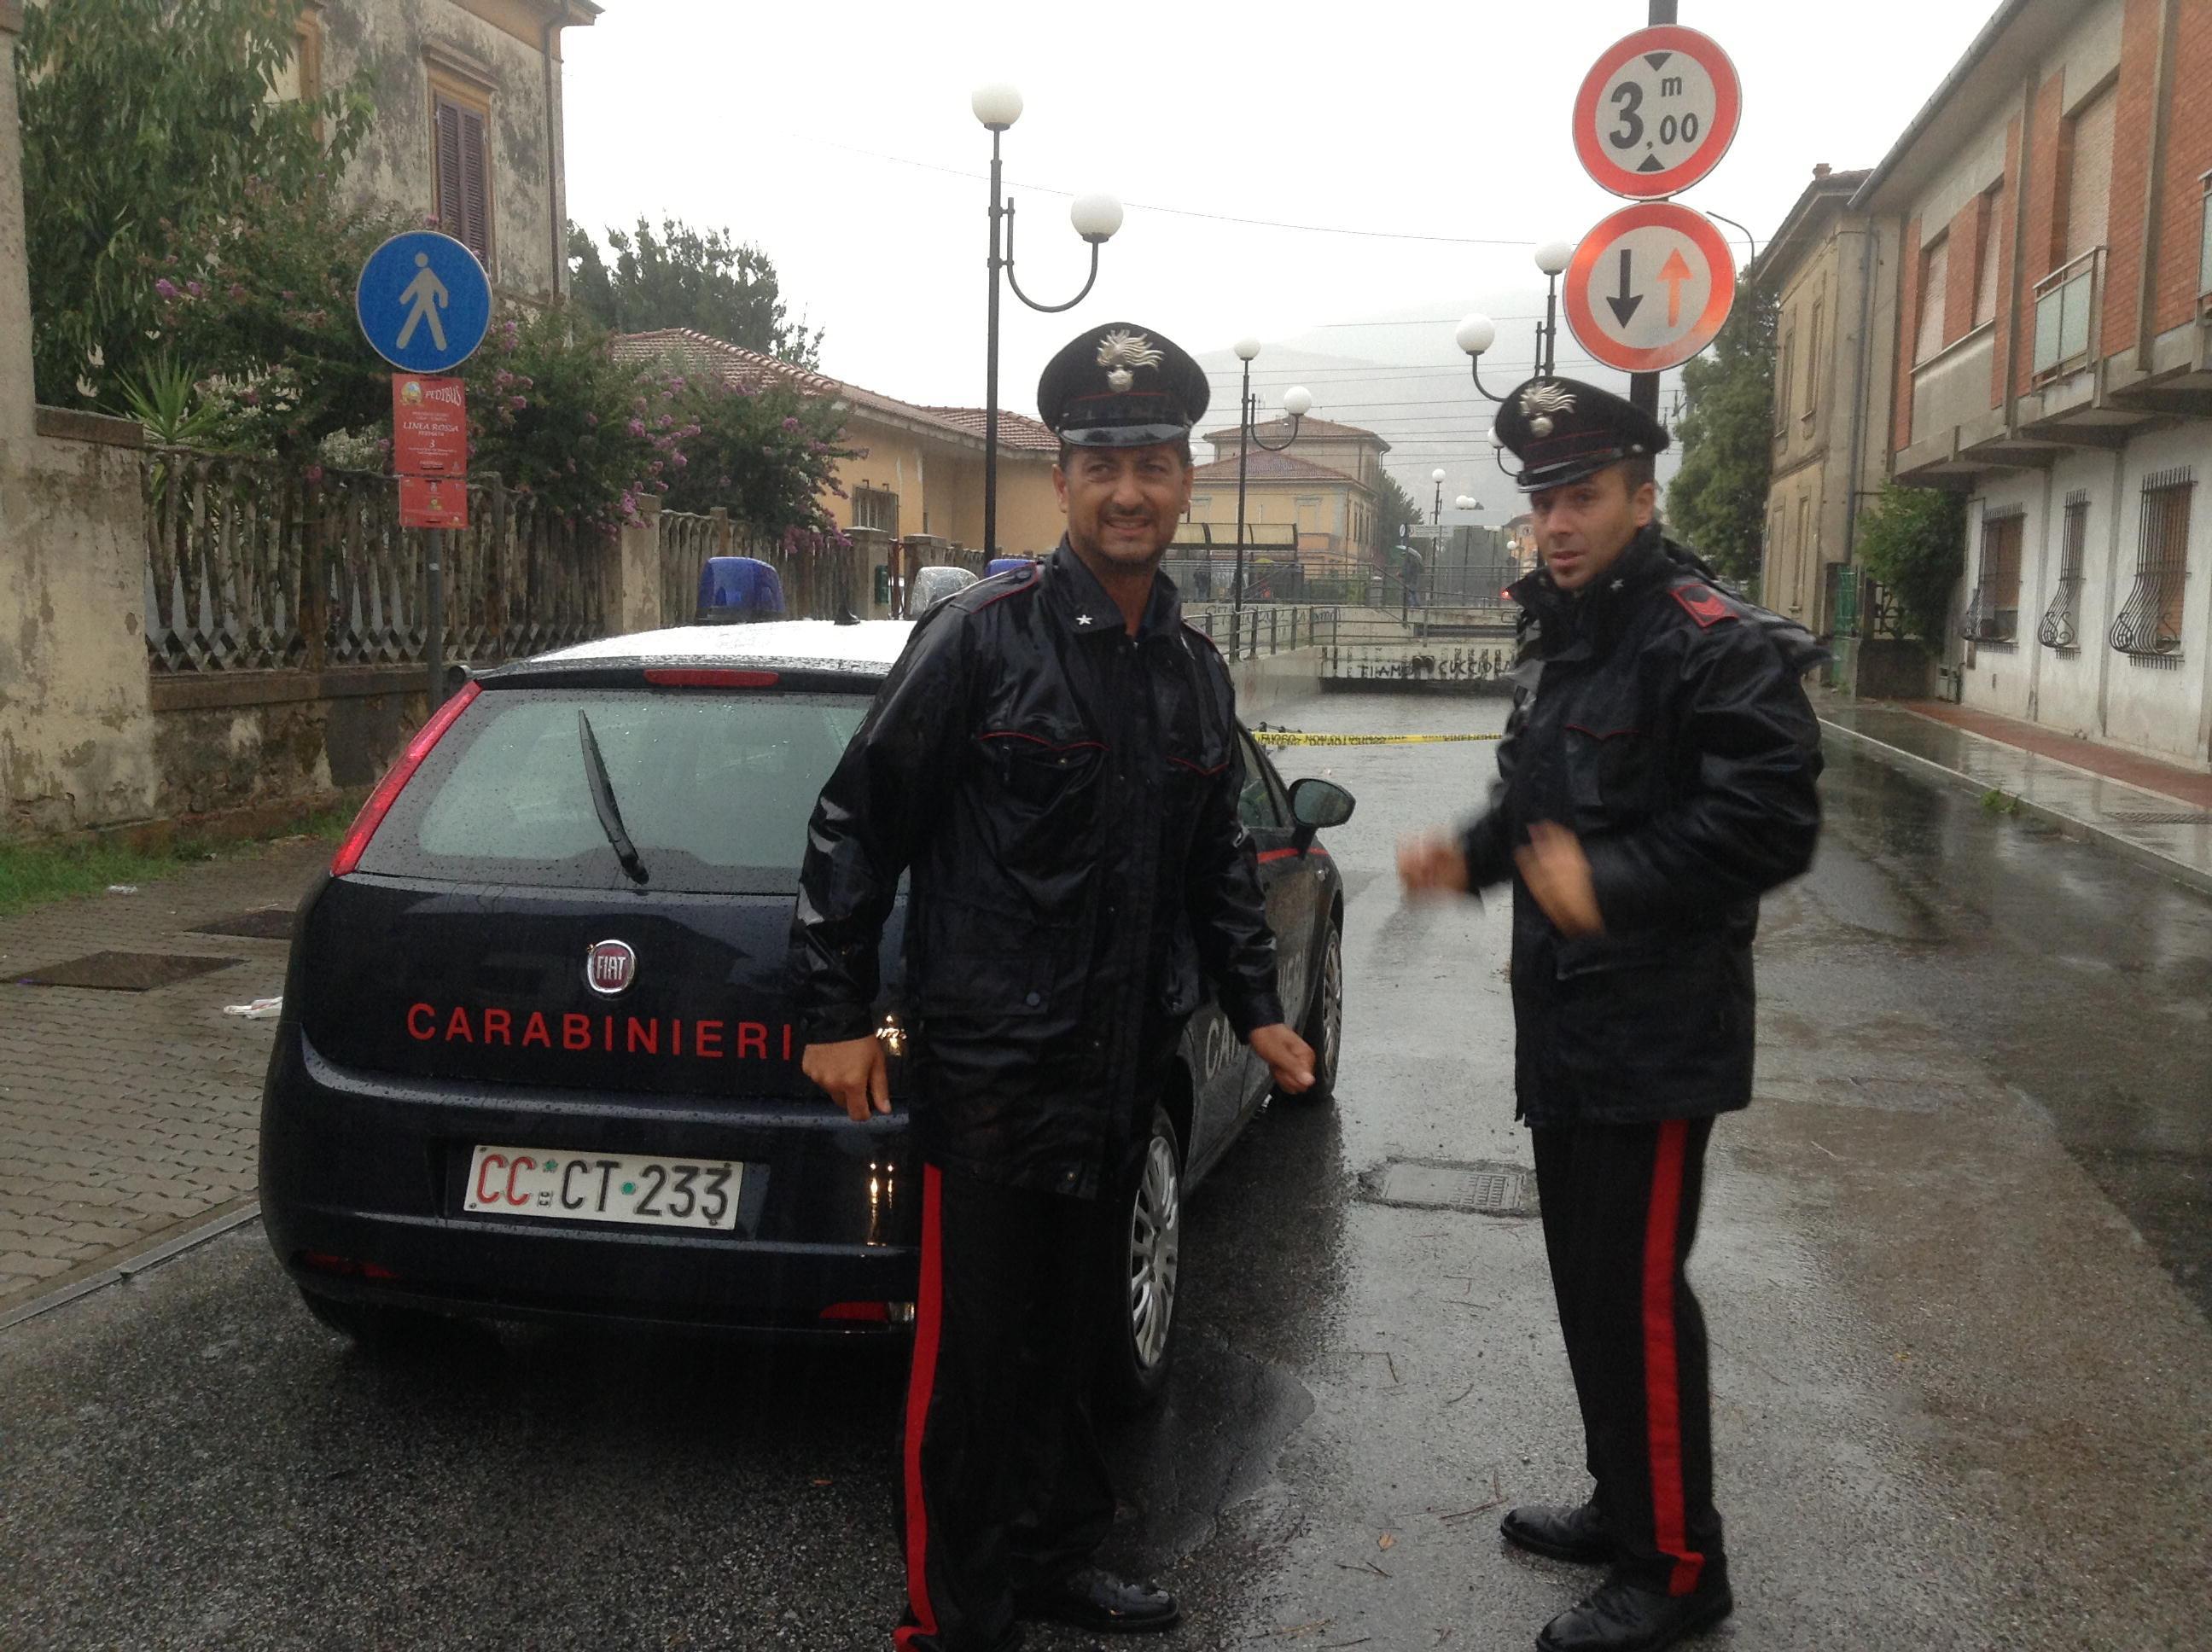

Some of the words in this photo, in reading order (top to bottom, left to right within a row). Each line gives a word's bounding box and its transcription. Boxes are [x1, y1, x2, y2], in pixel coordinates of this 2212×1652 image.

[1661, 75, 1682, 96] m
[423, 385, 462, 406] PEDIBUS
[403, 421, 429, 431] LINEA
[432, 423, 459, 432] ROSSA
[596, 955, 627, 981] FIAT
[406, 1002, 793, 1061] CARABINIERI
[475, 1153, 537, 1207] CC
[561, 1160, 623, 1212] CT
[634, 1165, 733, 1220] 233
